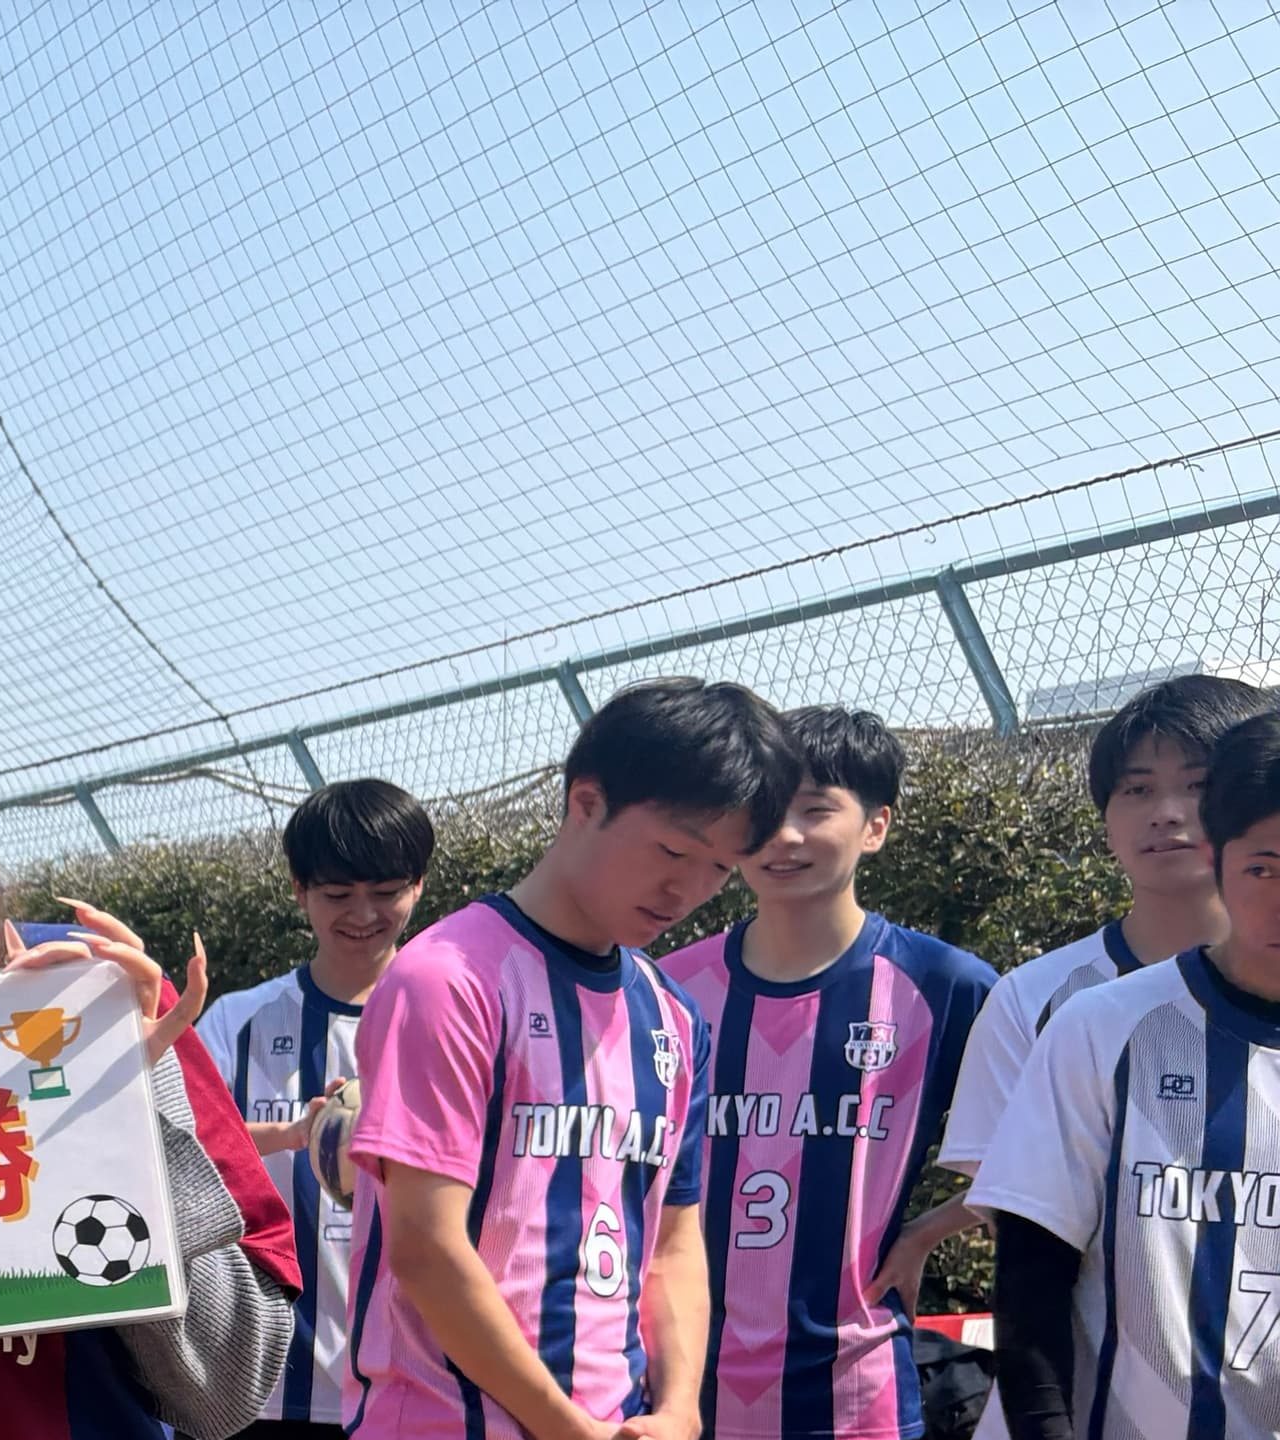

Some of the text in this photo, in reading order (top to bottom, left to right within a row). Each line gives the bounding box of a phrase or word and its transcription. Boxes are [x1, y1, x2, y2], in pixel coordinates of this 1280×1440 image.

[615, 1110, 676, 1168] A.C.
[707, 1092, 895, 1141] KYO A.C.C
[734, 1169, 791, 1249] 3
[1132, 1161, 1280, 1229] TOKYO
[584, 1202, 625, 1298] 6
[1229, 1270, 1280, 1371] 7
